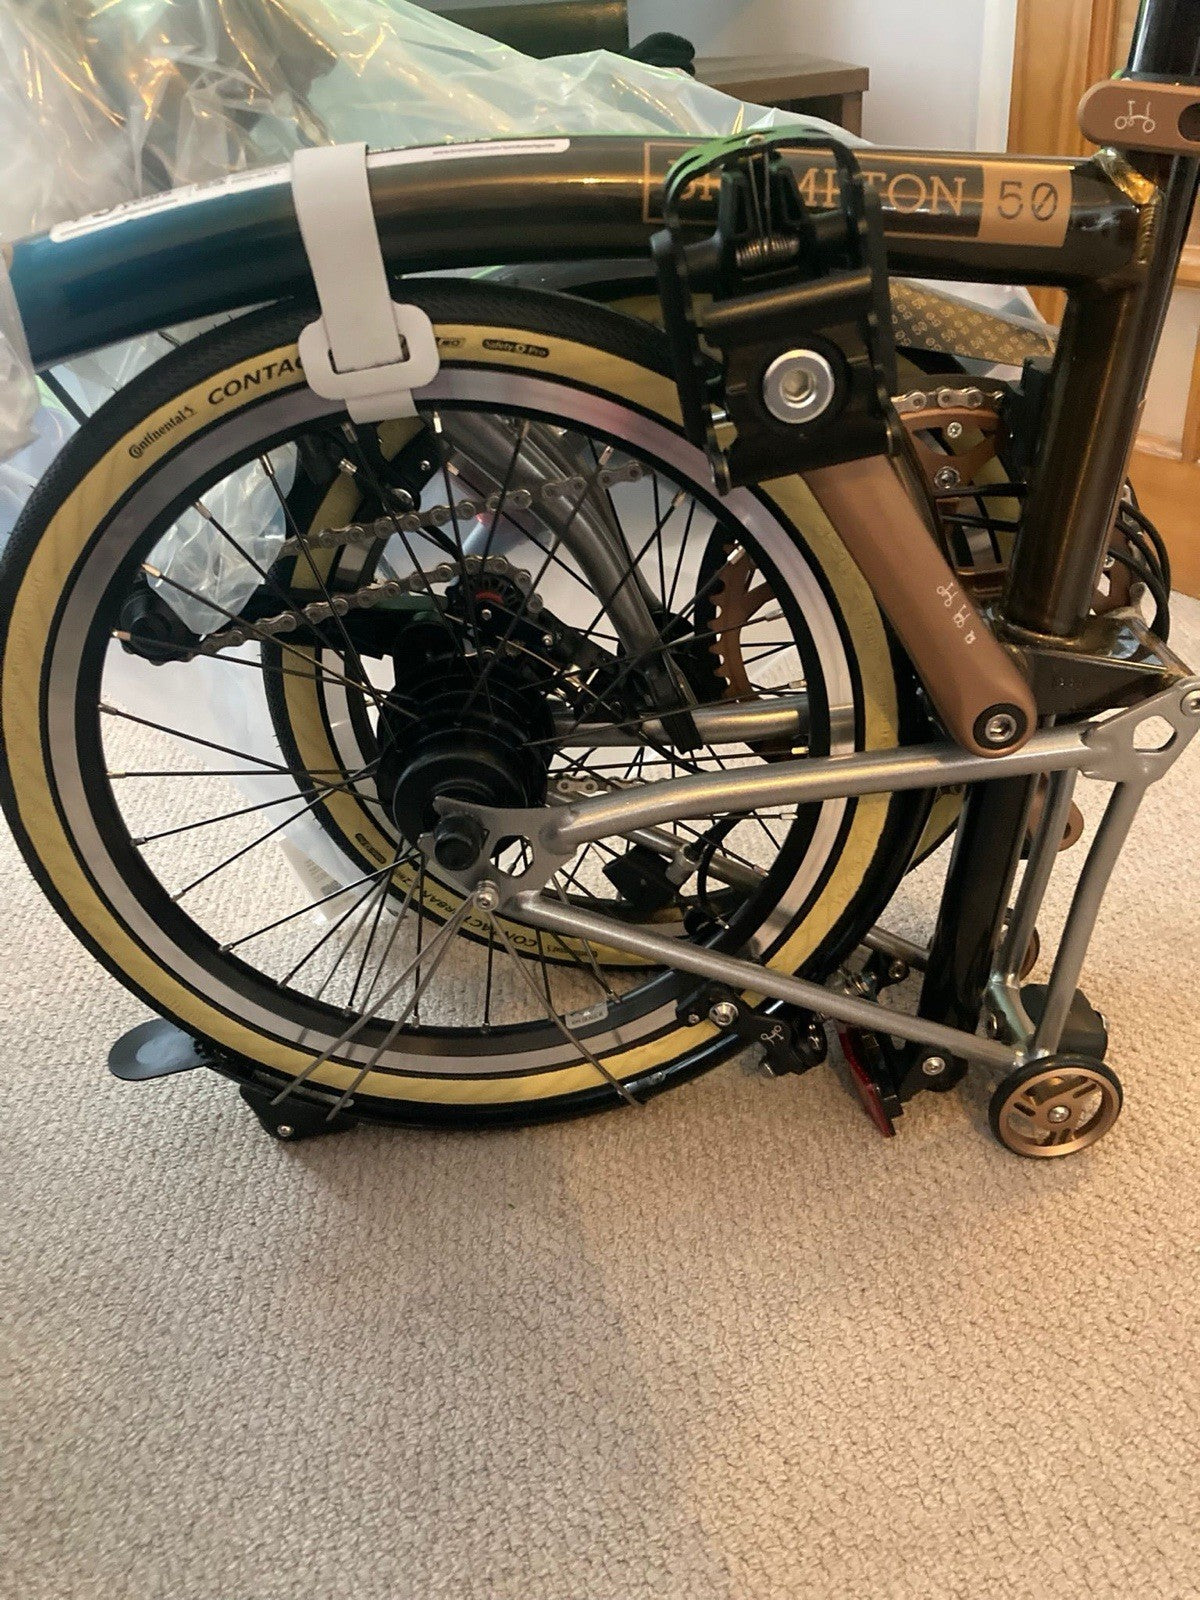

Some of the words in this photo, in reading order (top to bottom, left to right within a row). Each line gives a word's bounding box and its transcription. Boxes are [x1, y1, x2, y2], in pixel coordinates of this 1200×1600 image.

[998, 180, 1059, 221] 50
[128, 407, 188, 459] Continental
[421, 890, 457, 914] RBAN
[463, 915, 538, 947] CONACT
